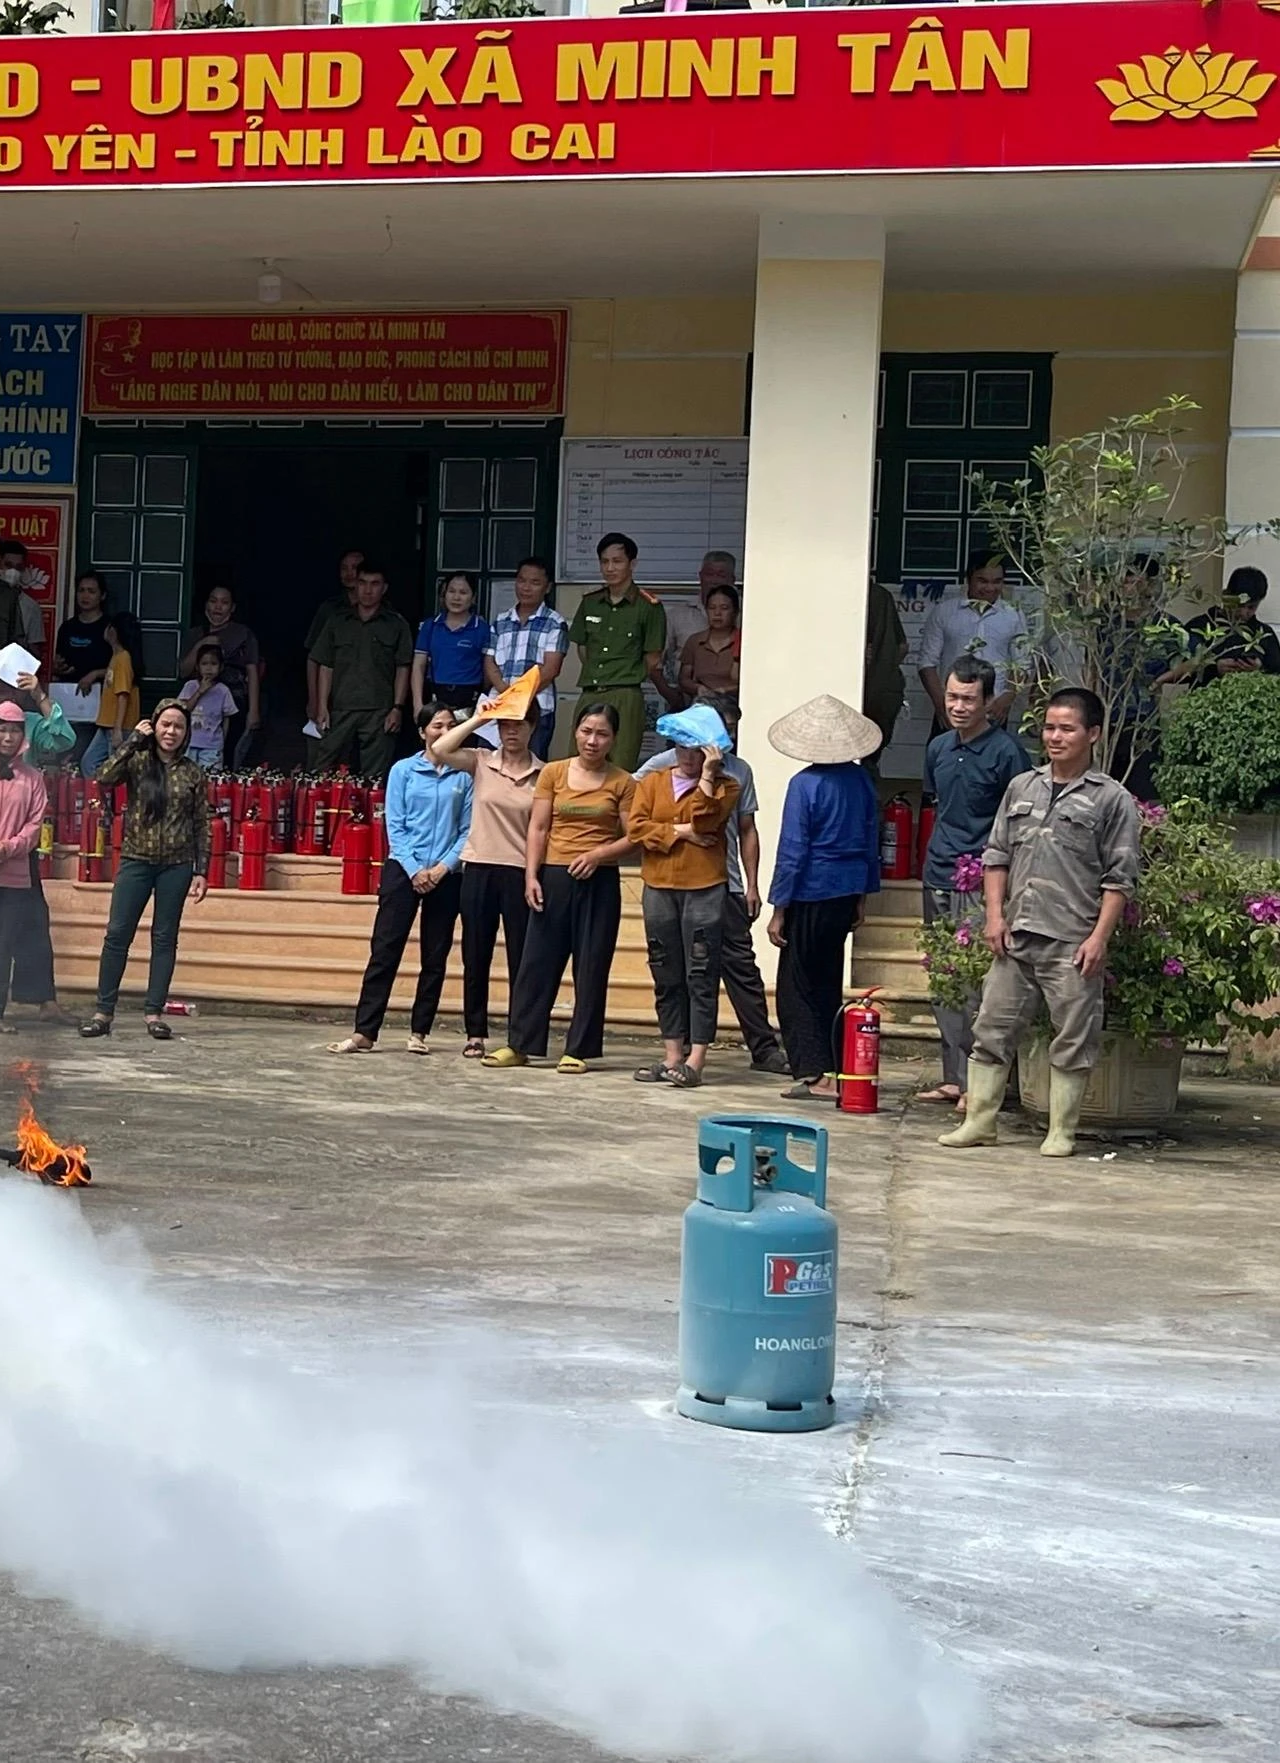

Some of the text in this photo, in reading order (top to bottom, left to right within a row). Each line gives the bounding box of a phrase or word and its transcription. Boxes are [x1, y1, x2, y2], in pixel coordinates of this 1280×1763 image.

[72, 79, 100, 91] -
[131, 52, 363, 115] UBND
[397, 29, 523, 106] XÃ
[557, 36, 797, 101] MINH
[838, 16, 1030, 93] TÂN
[44, 124, 156, 170] YÊN
[174, 149, 196, 158] -
[211, 115, 344, 167] TỈNH
[368, 114, 482, 164] LÀO
[511, 122, 615, 161] CAI
[11, 324, 77, 353] TAY
[246, 351, 274, 369] THEO
[395, 350, 436, 369] PHONG
[516, 350, 549, 368] MINH
[160, 383, 198, 401] NGHE
[201, 379, 231, 402] DÂN
[297, 383, 326, 402] CHO
[331, 379, 361, 402] DÂN
[407, 379, 439, 402] LÀM
[443, 383, 473, 402] CHO
[477, 379, 508, 402] DÂN
[796, 1261, 832, 1281] Gas
